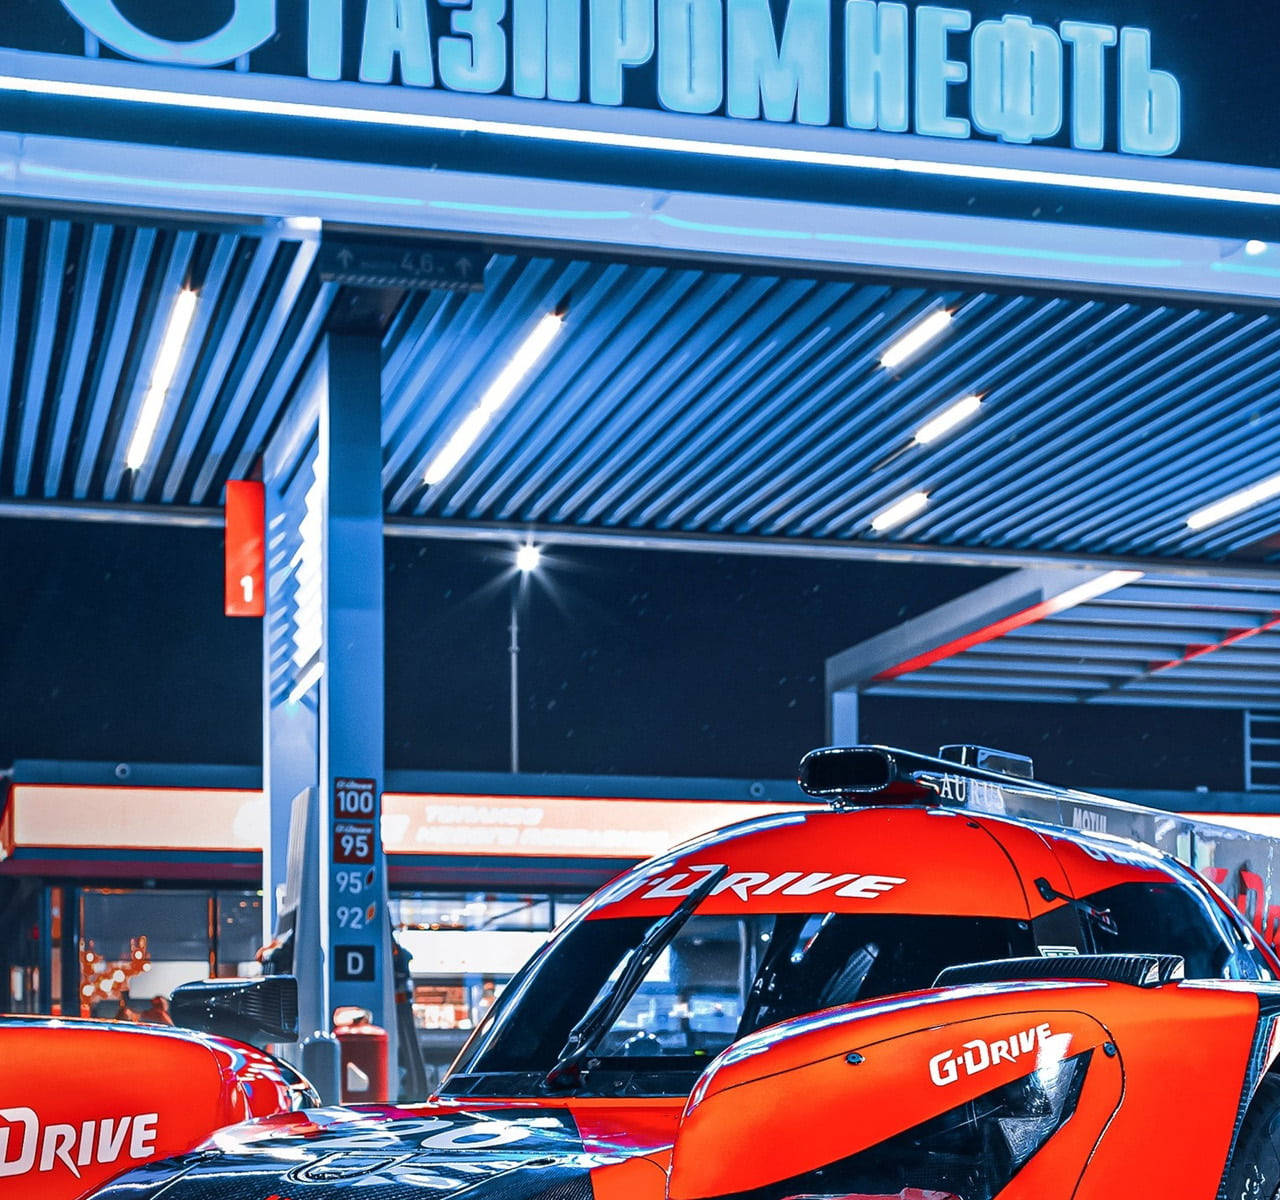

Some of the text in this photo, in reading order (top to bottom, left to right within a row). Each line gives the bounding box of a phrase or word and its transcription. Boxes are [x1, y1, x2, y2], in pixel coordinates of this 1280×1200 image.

[240, 575, 253, 602] 1
[337, 791, 373, 813] 100
[341, 834, 369, 858] 95
[336, 871, 362, 894] 95
[336, 906, 363, 930] 92
[347, 951, 364, 975] D
